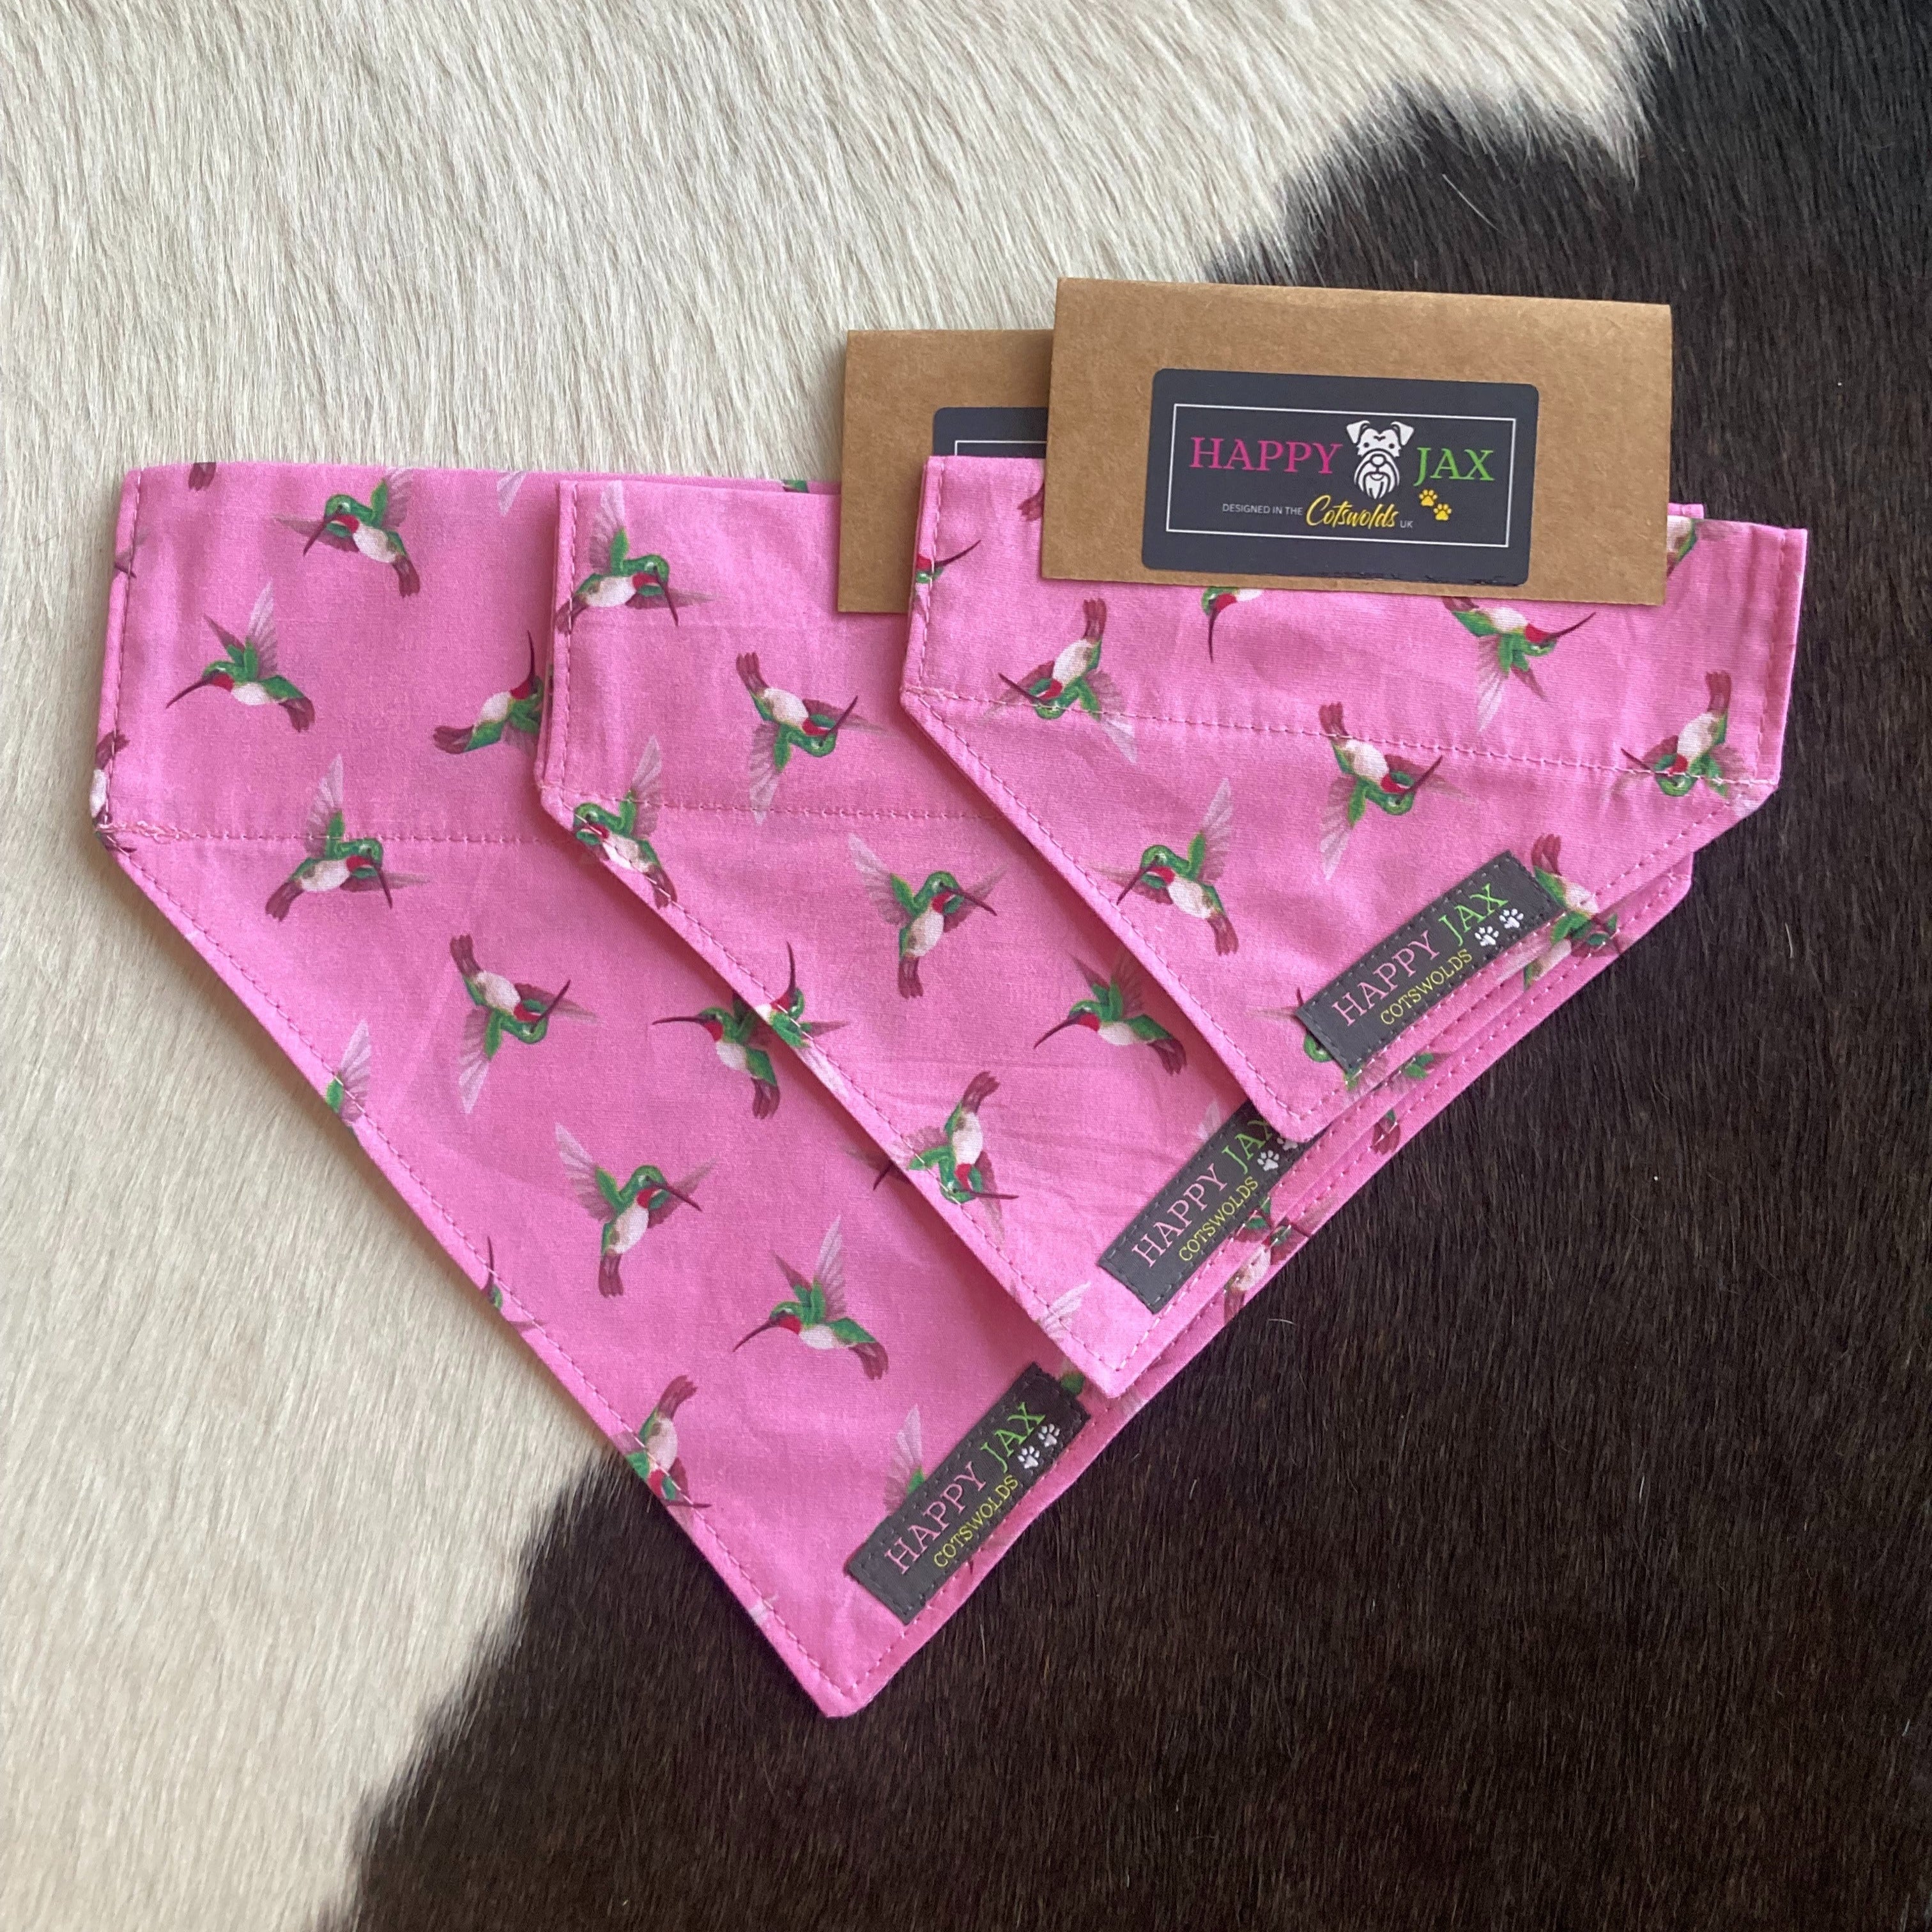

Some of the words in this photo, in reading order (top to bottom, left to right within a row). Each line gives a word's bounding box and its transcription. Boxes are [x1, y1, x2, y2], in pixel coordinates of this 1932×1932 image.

[1189, 436, 1343, 475] HAPPY
[1413, 447, 1495, 487] JAX
[1222, 503, 1271, 516] DESIGNED
[1272, 505, 1283, 516] IN
[1284, 506, 1304, 517] THE
[1305, 494, 1399, 528] Cotswolds
[1400, 519, 1413, 530] UK
[1331, 930, 1441, 1027] HAPPY
[1438, 882, 1509, 947] JAX
[1380, 948, 1473, 1025] COTSWOLDS
[1131, 1163, 1228, 1268] HAPPY
[1179, 1176, 1259, 1262] COTSWOLDS
[884, 1460, 986, 1575] HAPPY
[979, 1401, 1046, 1473] JAX
[933, 1474, 1019, 1568] COTSWOLDS
